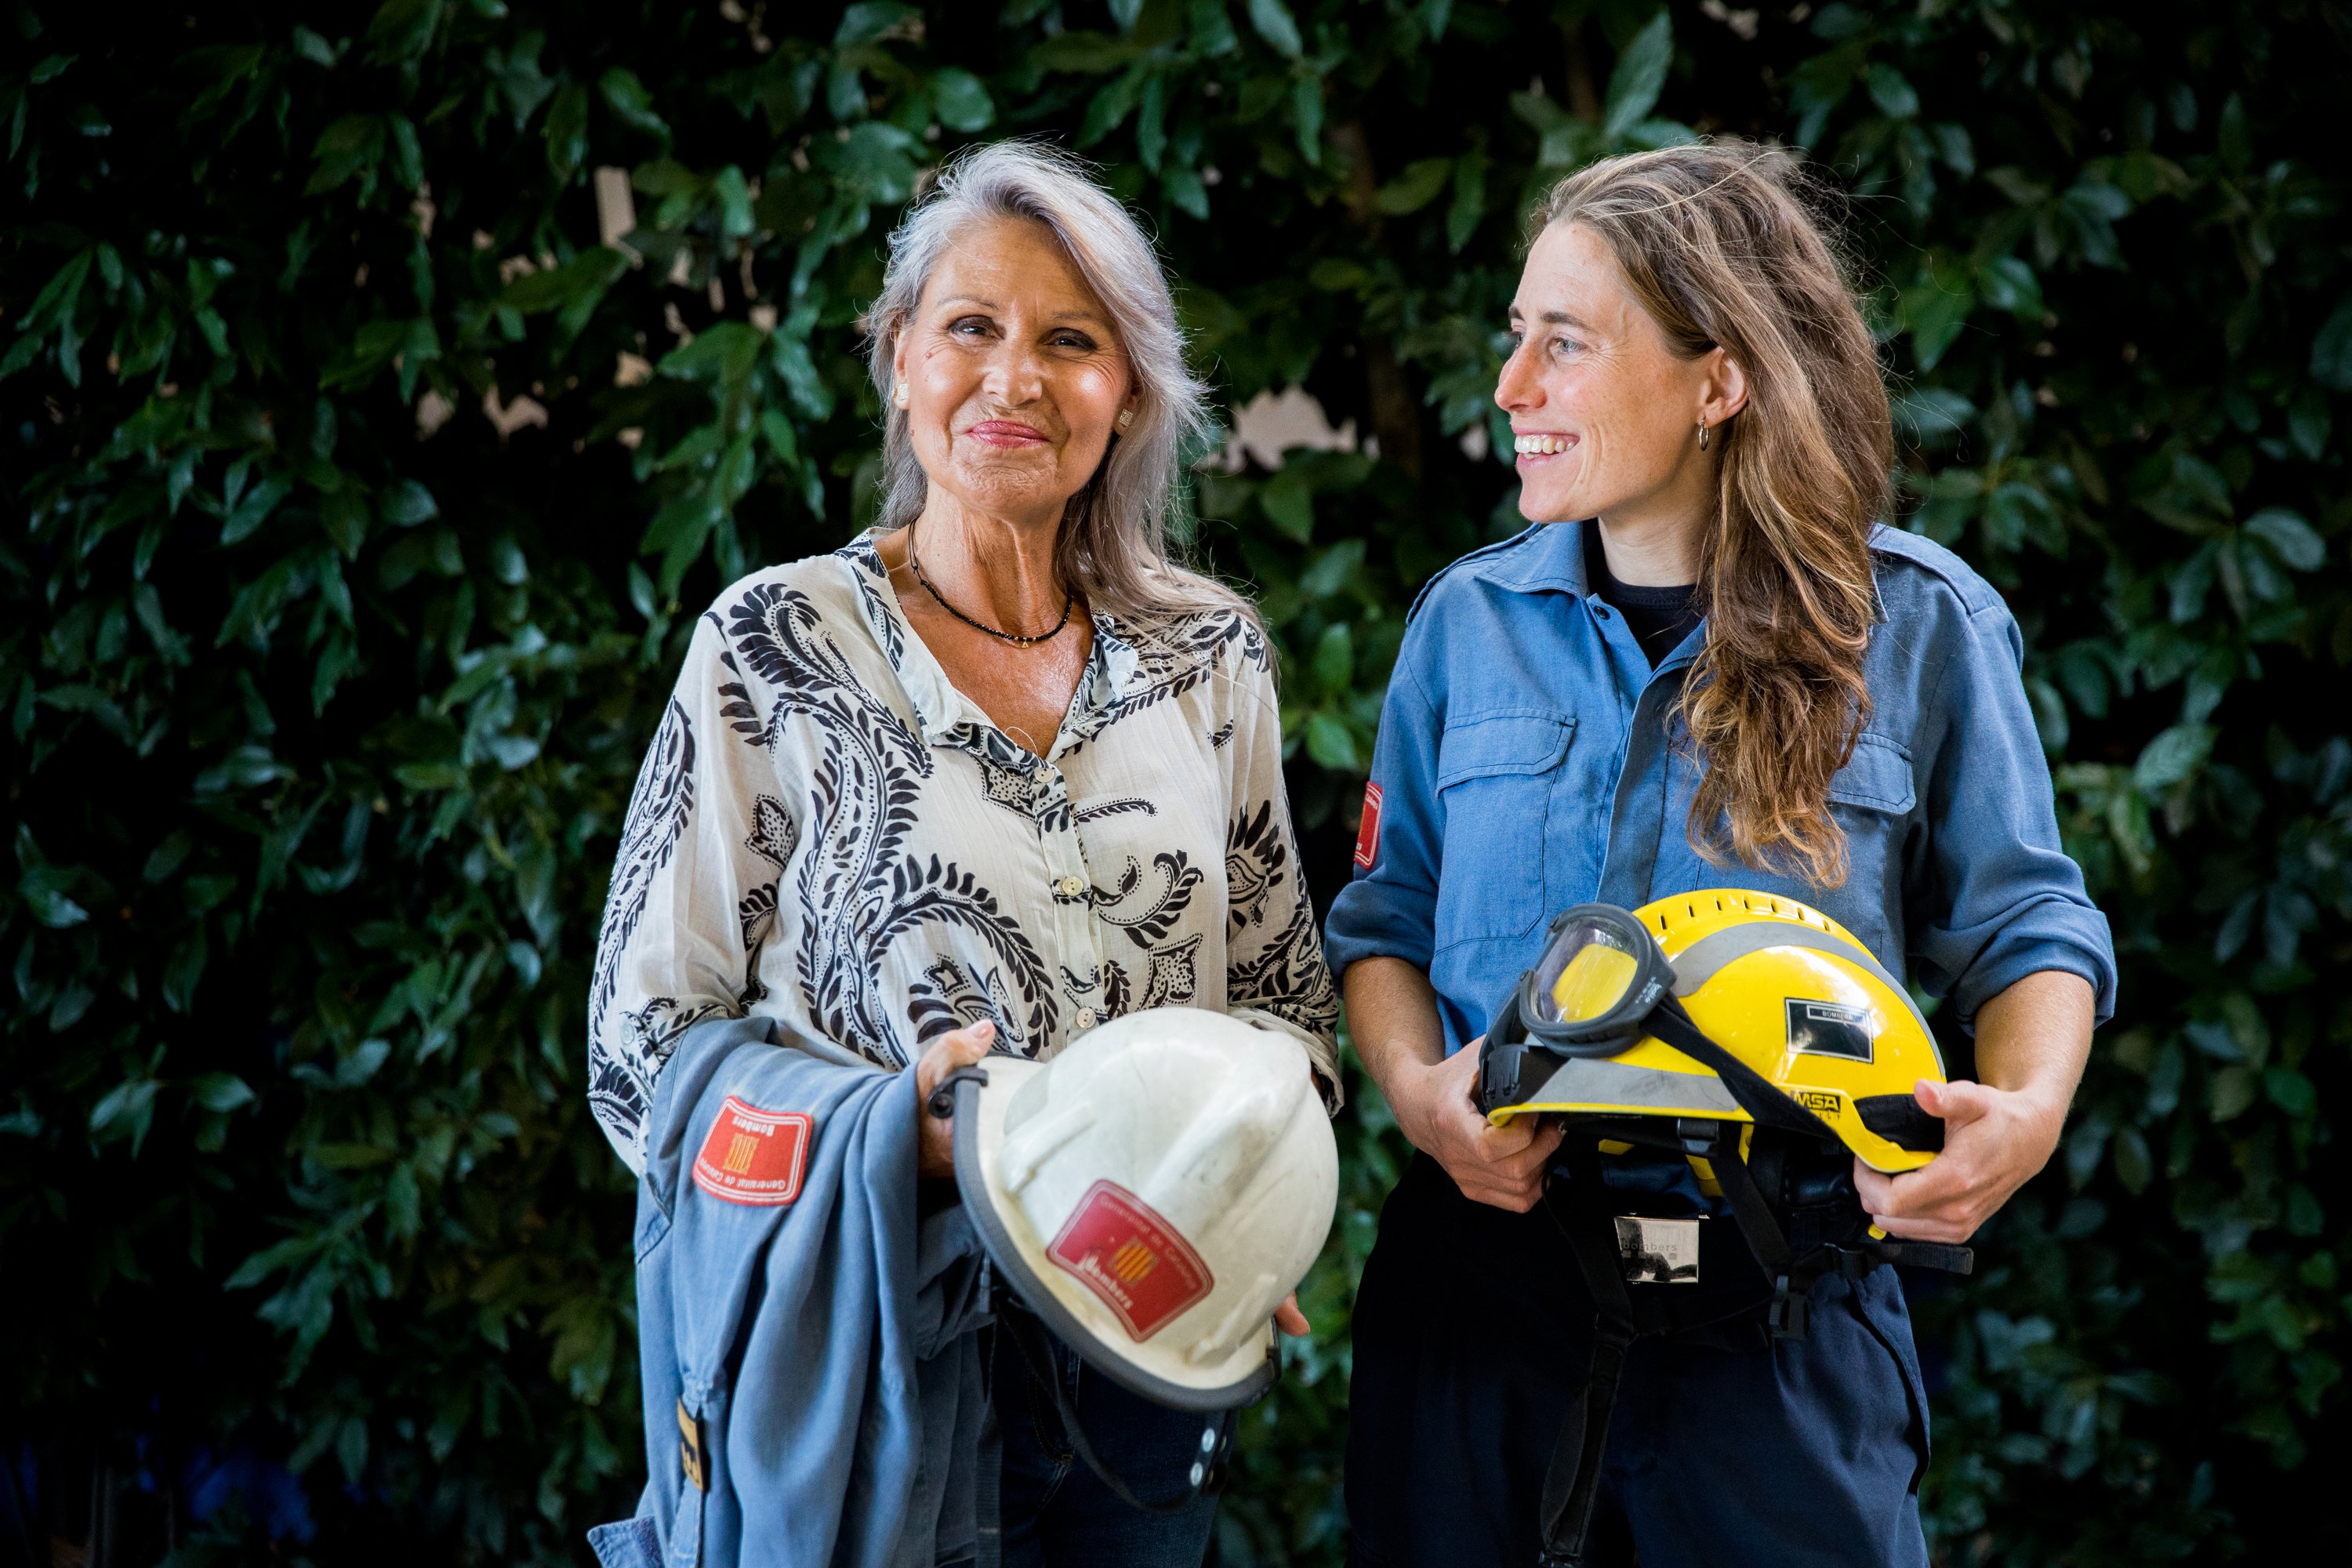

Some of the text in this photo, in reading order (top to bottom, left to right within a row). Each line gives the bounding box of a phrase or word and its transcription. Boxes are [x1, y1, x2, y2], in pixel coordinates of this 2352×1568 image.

[1793, 1092, 1839, 1112] MSA
[731, 1116, 775, 1137] Bombers
[724, 1175, 736, 1186] de
[738, 1178, 786, 1191] Generalitat
[1622, 1241, 1678, 1252] bombers
